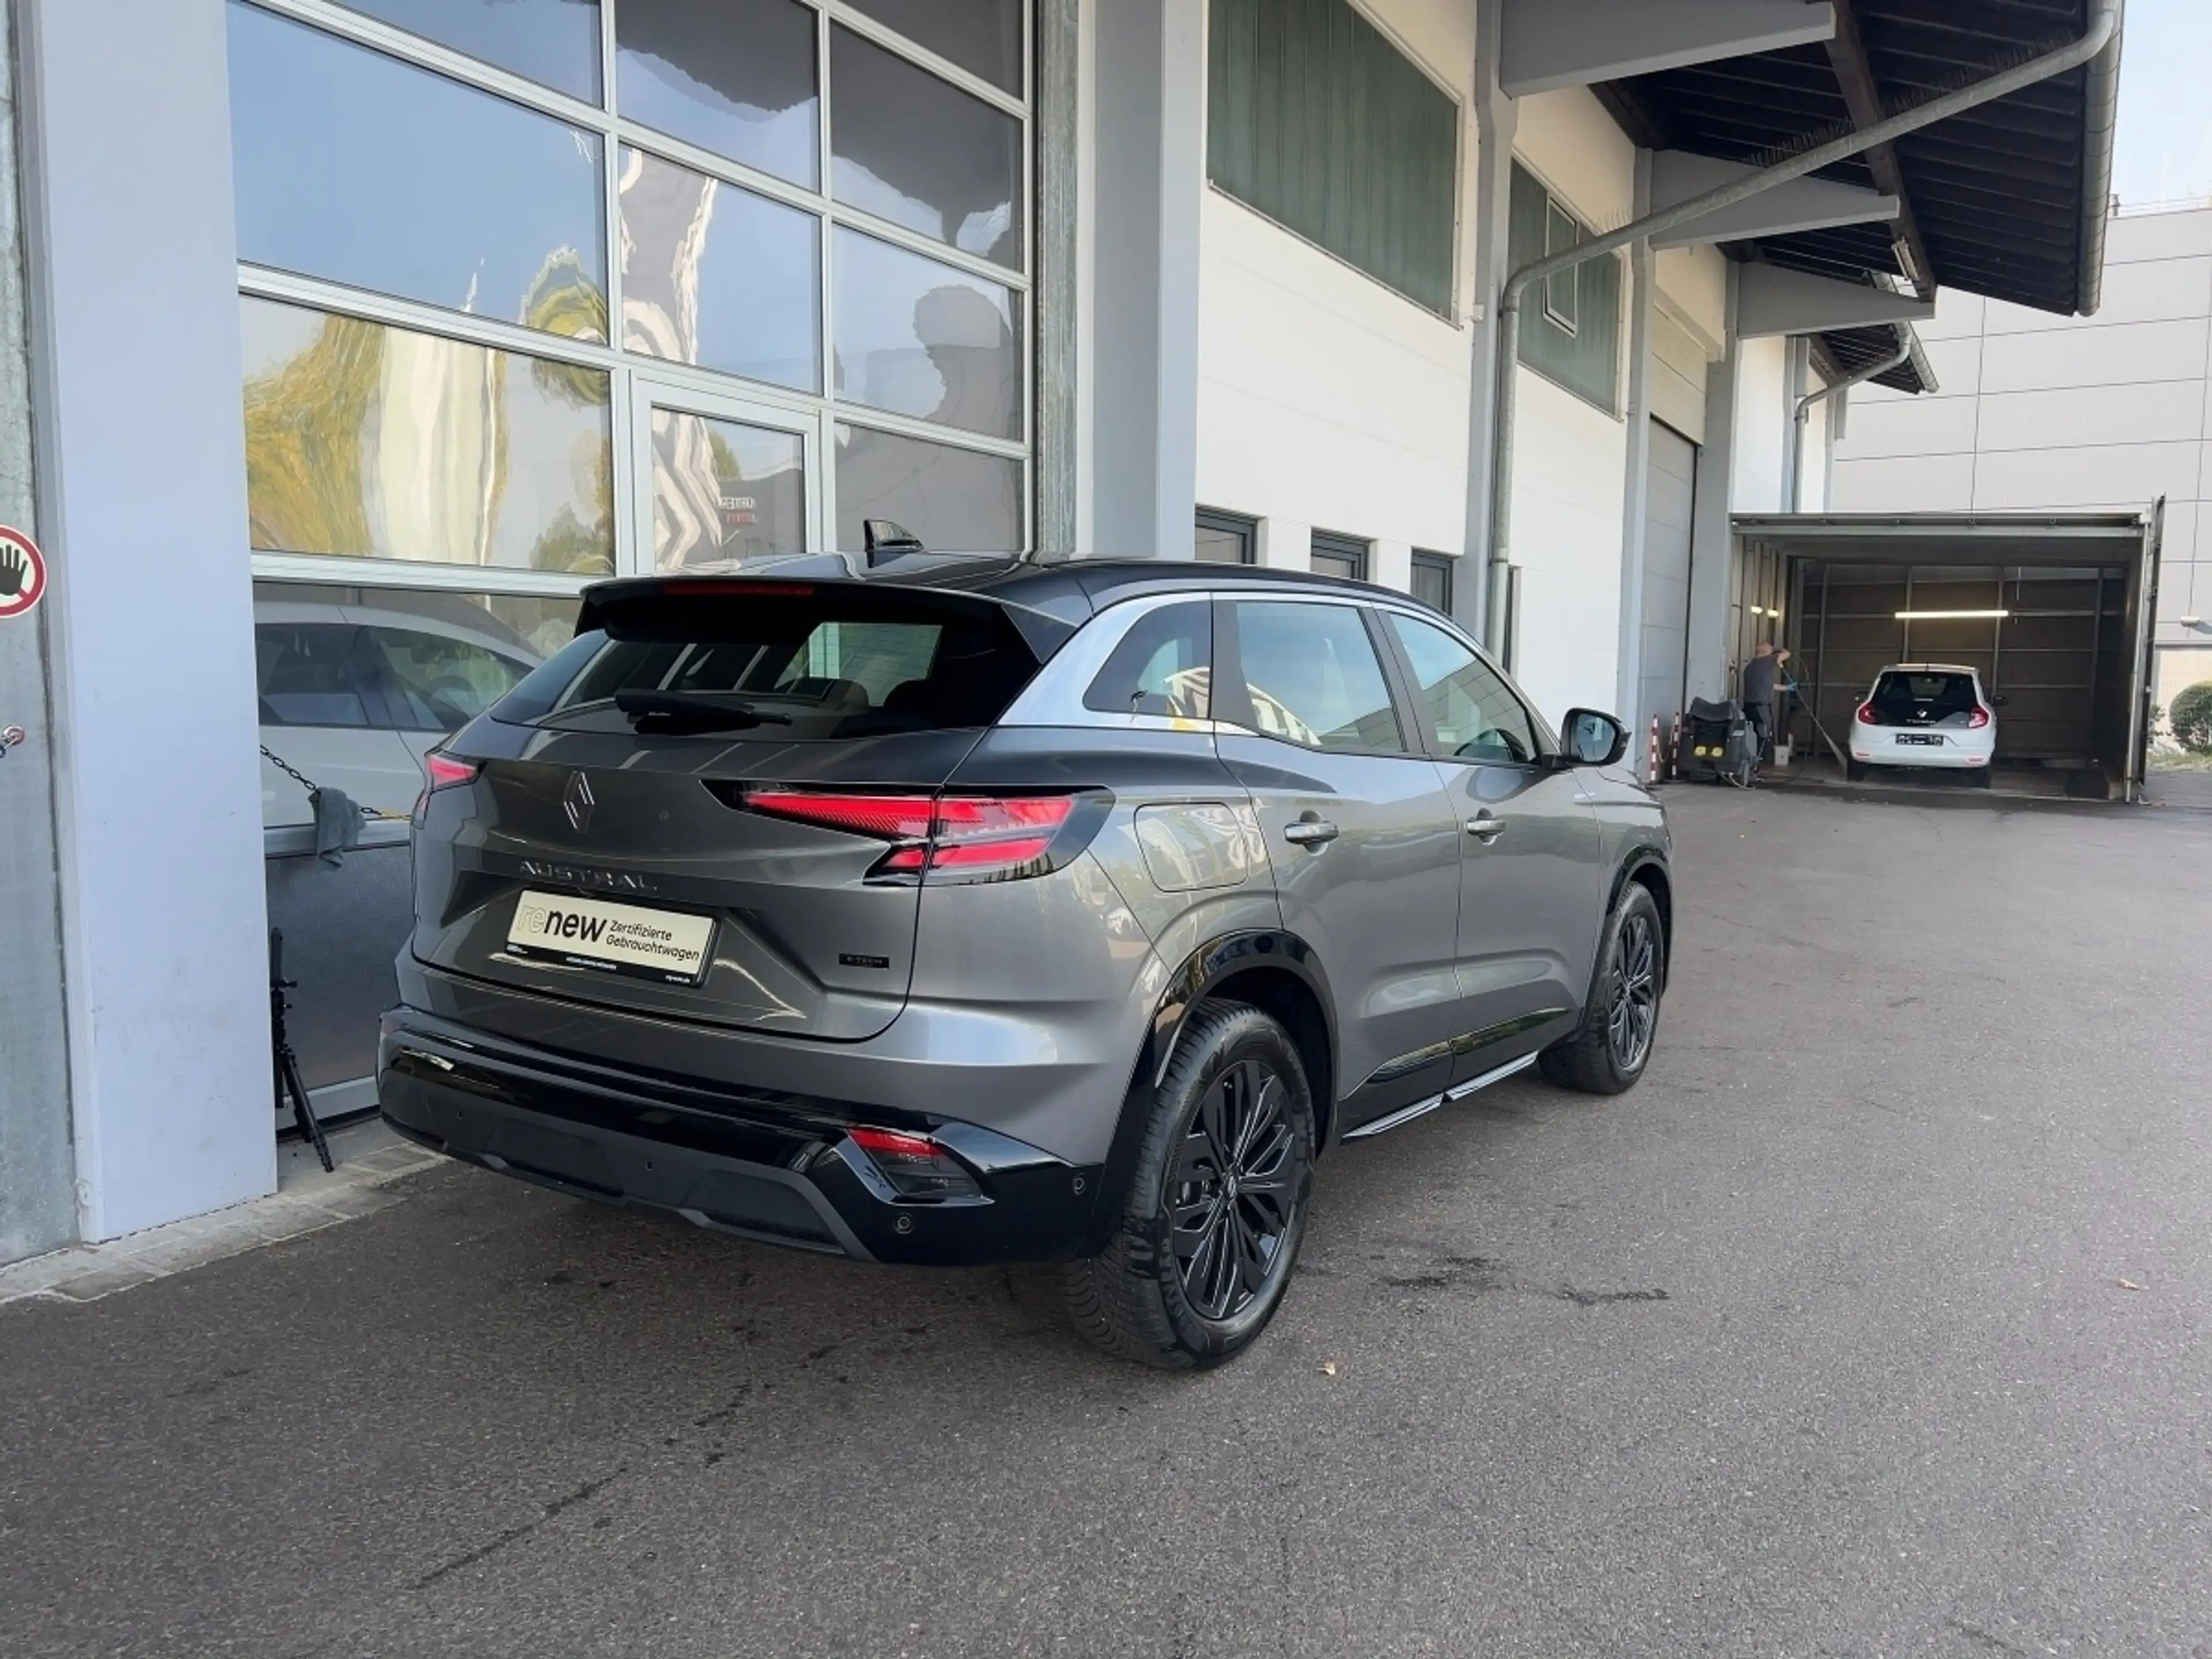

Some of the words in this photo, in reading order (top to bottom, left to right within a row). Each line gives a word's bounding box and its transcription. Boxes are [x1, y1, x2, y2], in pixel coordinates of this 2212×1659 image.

[520, 861, 658, 891] AUSTRAL
[517, 904, 607, 943] renew
[609, 919, 673, 941] Zertifizierte
[605, 934, 700, 961] Gebrauchtwagen
